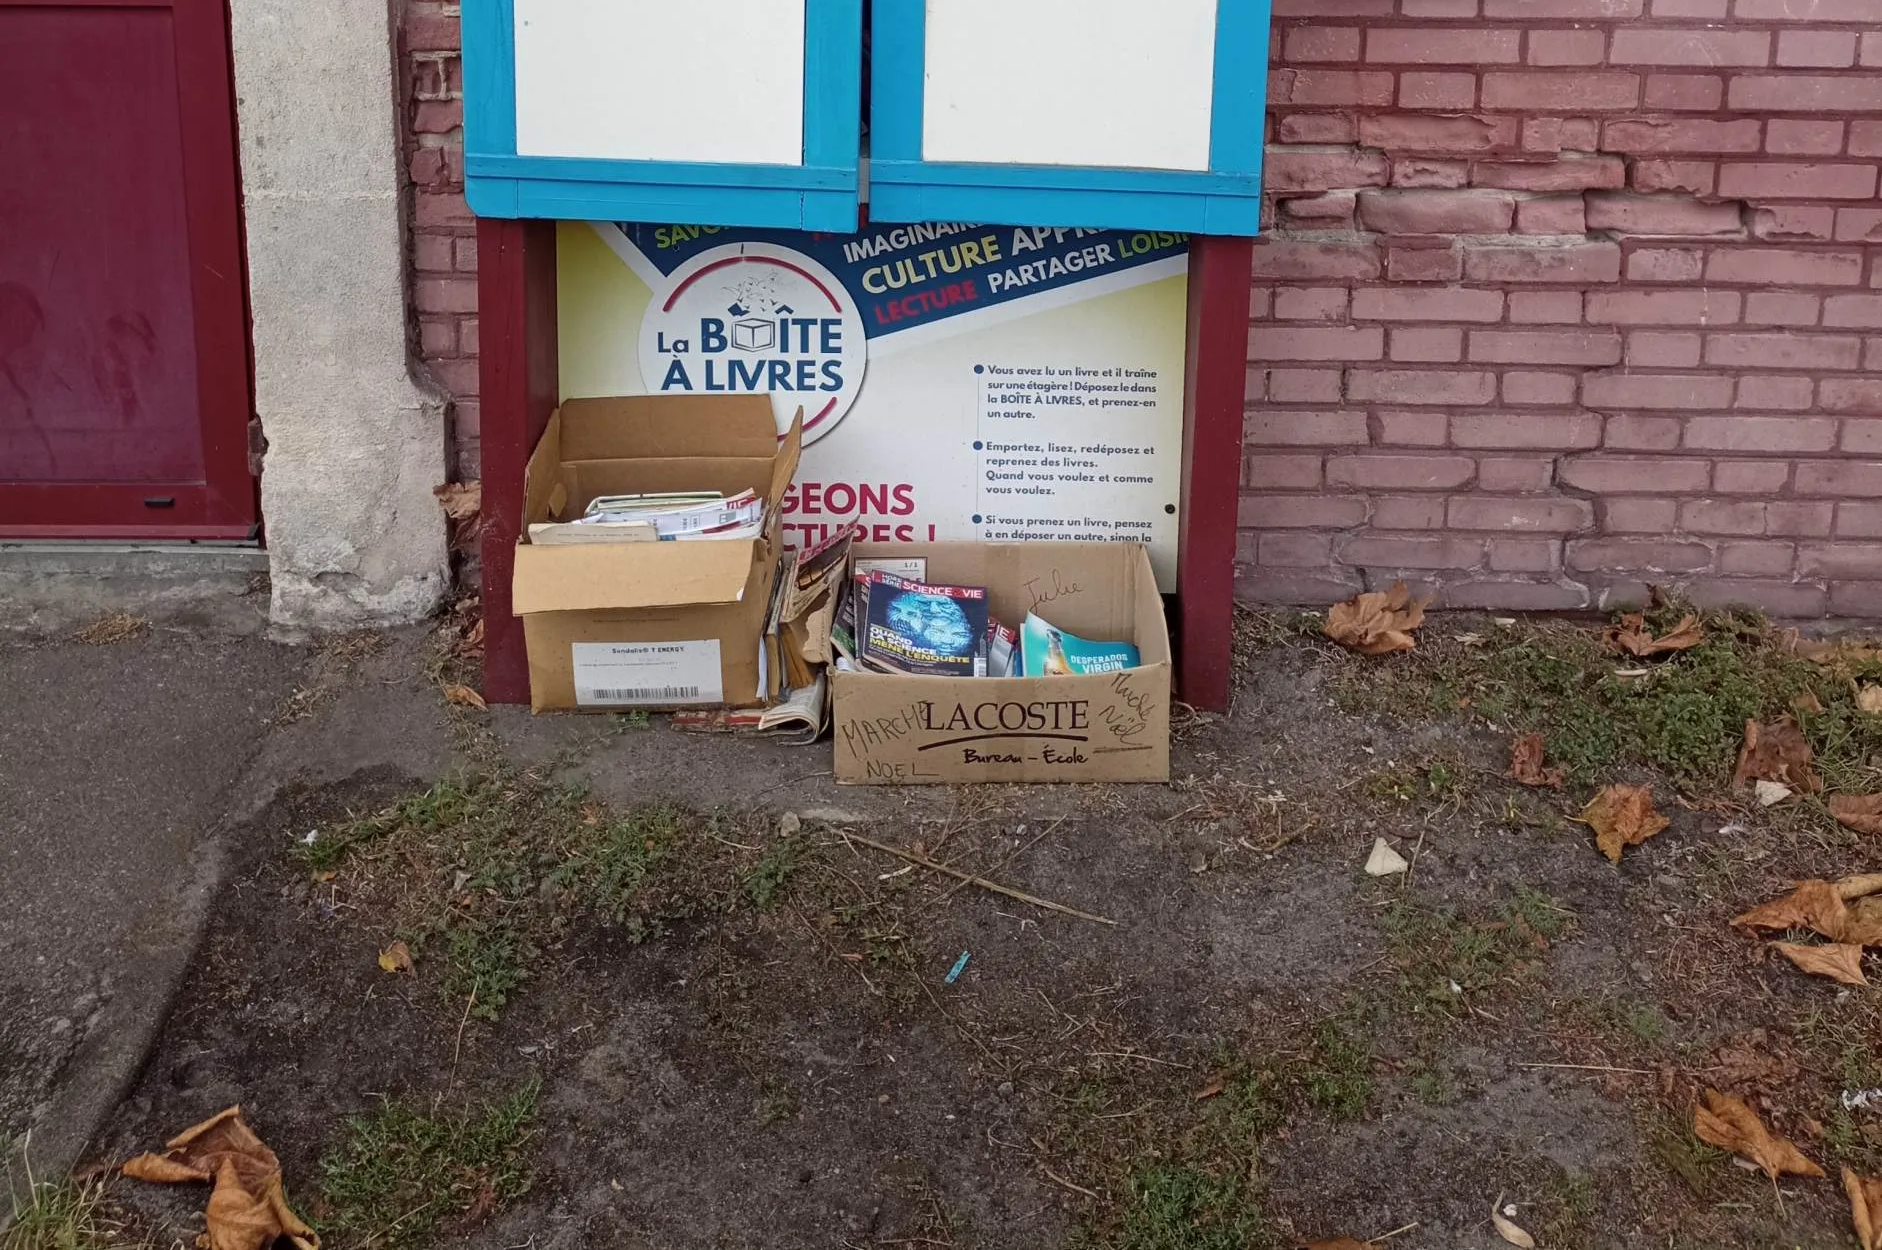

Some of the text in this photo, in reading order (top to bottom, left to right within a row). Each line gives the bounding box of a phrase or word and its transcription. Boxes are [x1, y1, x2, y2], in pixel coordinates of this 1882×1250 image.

[862, 235, 1002, 294] CULTURE
[875, 280, 977, 325] LECTURE
[988, 243, 1115, 294] PARTAGER
[657, 331, 690, 353] La
[660, 355, 844, 392] À LIVRES
[987, 365, 1158, 379] Vous avez lu un livre et il traîne
[987, 382, 1004, 390] sur
[1006, 382, 1026, 391] une
[1026, 380, 1068, 393] étagère
[1074, 381, 1119, 394] Déposez
[1120, 382, 1129, 392] le
[1130, 383, 1157, 393] dans
[987, 391, 1157, 409] la BOÎTE À LIVRES, et prenez-en
[987, 408, 1036, 419] un autre.
[986, 441, 1155, 456] Emportez, lisez, redéposez et
[985, 456, 1098, 468] reprenez des livres.
[985, 470, 1154, 484] Quand vous voulez et comme
[985, 485, 1056, 496] vous voulez.
[985, 514, 1153, 530] Si vous prenez un livre, pensez
[985, 529, 1152, 543] à en déposer un autre, sinon la
[902, 580, 953, 597] SCIENCE
[962, 588, 983, 599] VIE
[870, 626, 913, 645] QUAND
[657, 646, 685, 654] ENERGY
[869, 632, 885, 641] LA
[886, 637, 938, 656] SCIENCE
[1070, 654, 1128, 665] DESPERADOS
[1081, 660, 1124, 674] VIRGIN
[924, 700, 1089, 732] LACOSTE
[963, 747, 1023, 764] Bureau
[1043, 744, 1089, 765] École
